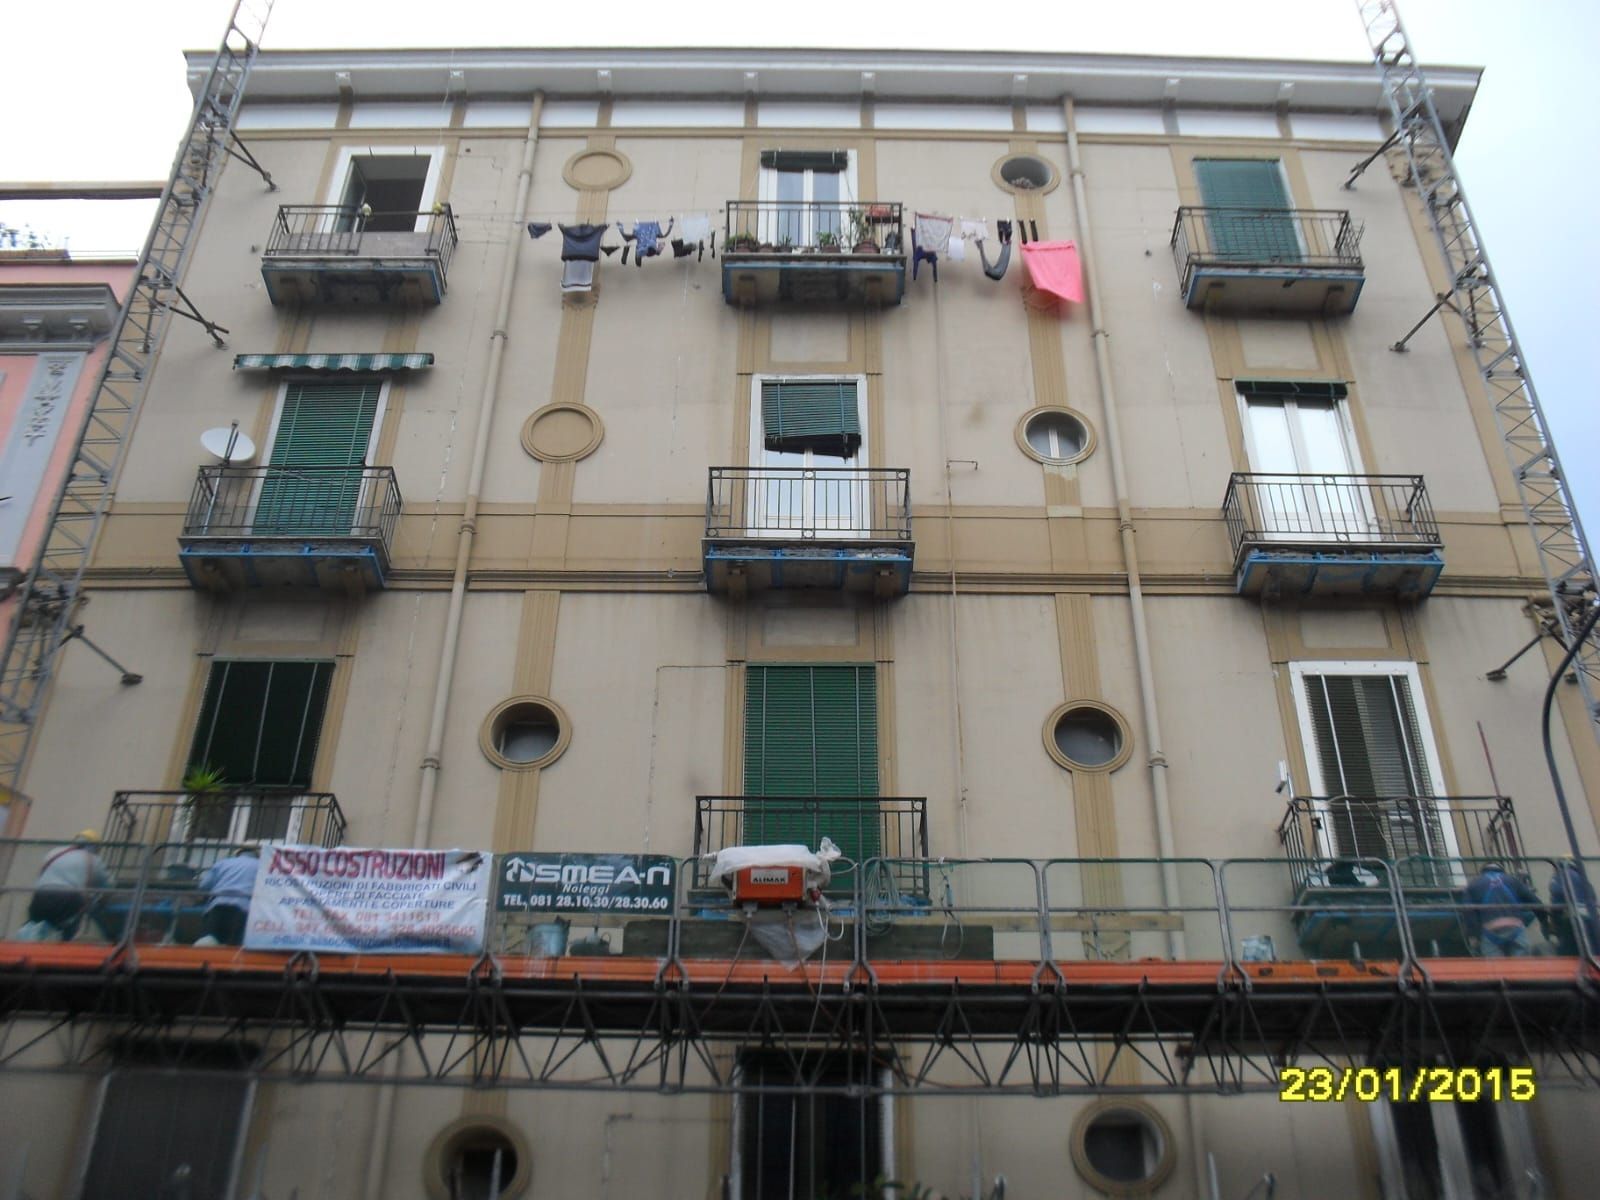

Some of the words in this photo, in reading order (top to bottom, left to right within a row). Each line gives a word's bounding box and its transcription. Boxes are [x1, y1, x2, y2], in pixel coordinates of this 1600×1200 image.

[268, 848, 320, 877] ASSO
[324, 850, 446, 880] COSTRUZIONI
[356, 880, 368, 890] DI
[371, 881, 440, 892] FABBRICATI
[444, 881, 477, 892] CIVILI
[562, 883, 610, 896] Noleggi
[354, 891, 366, 900] DI
[382, 900, 455, 911] COPERTURE
[530, 894, 552, 907] 081
[556, 895, 668, 910] 28.10.30/28.30.60
